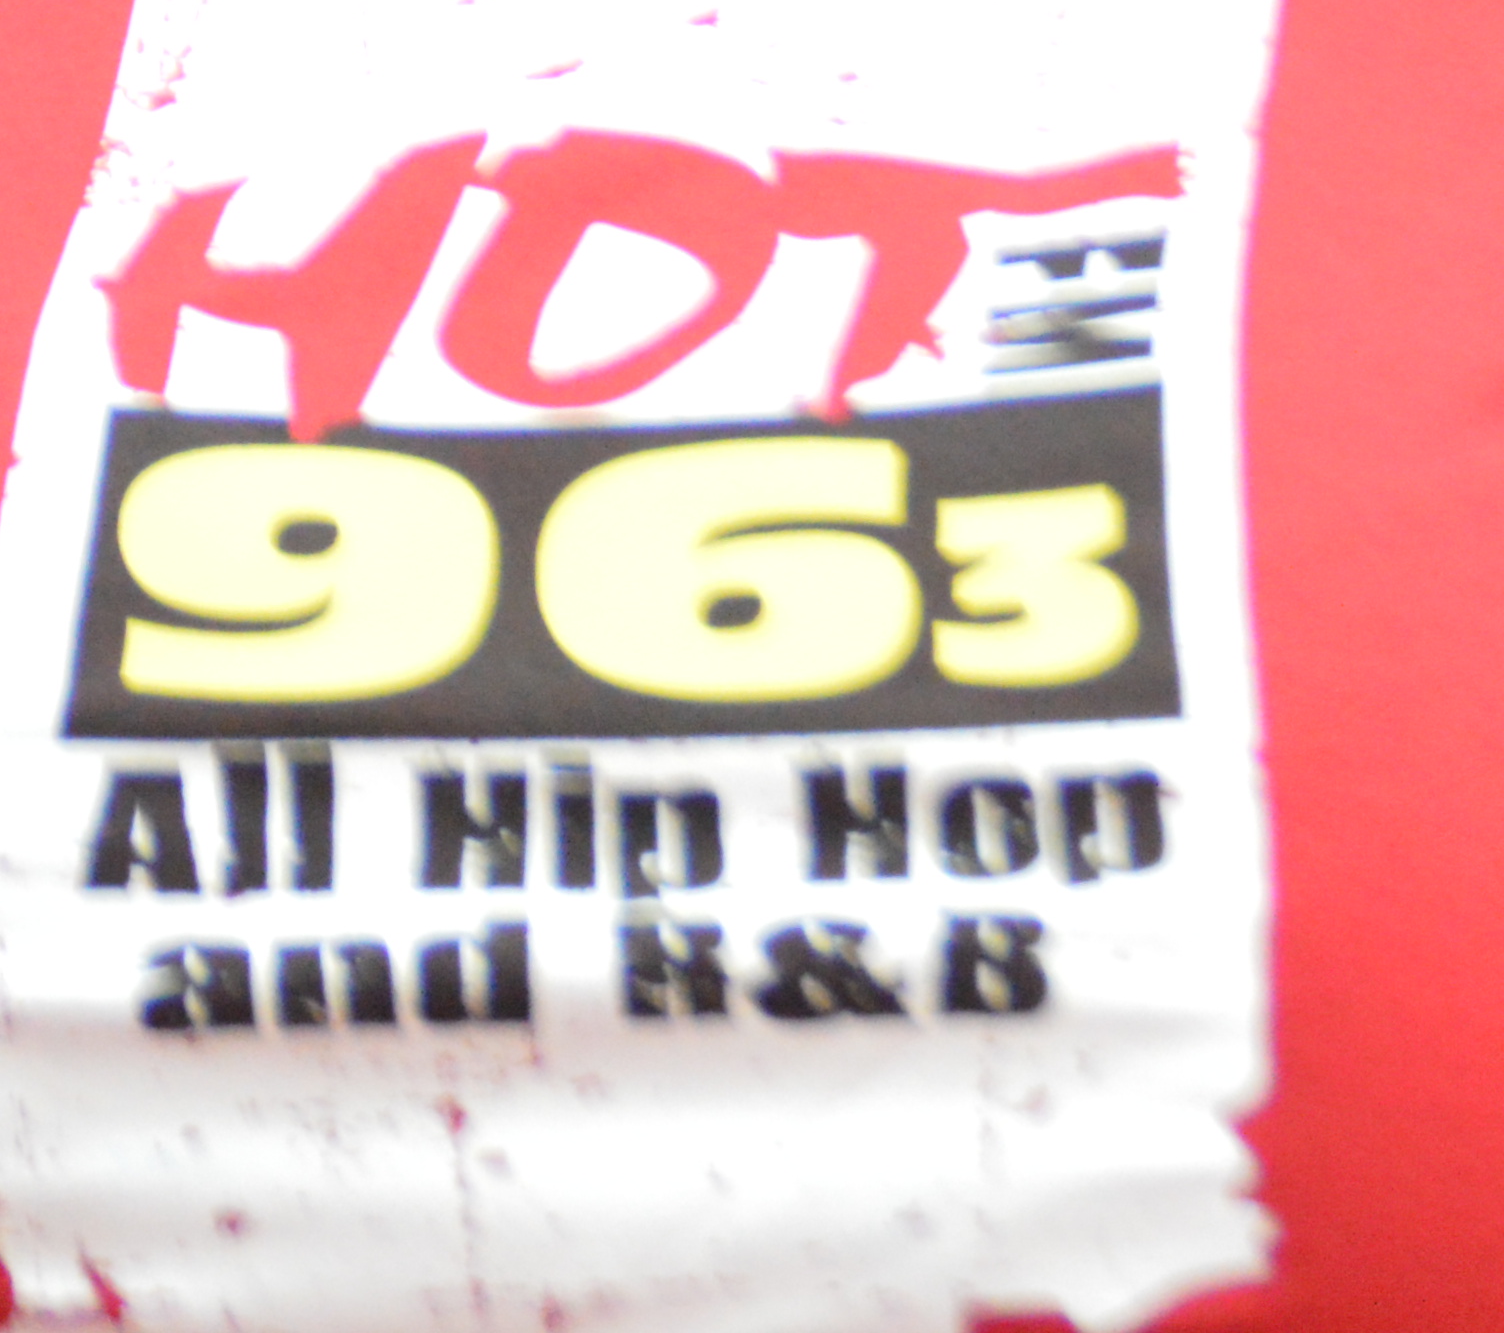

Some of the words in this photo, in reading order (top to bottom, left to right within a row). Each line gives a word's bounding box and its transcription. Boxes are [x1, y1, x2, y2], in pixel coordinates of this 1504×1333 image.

[93, 126, 1192, 443] HOT
[985, 226, 1169, 376] FM
[84, 741, 336, 894] All
[417, 746, 724, 901] Hip
[799, 760, 1166, 884] Hop
[141, 921, 531, 1026] and
[618, 911, 1050, 1019] R&B
